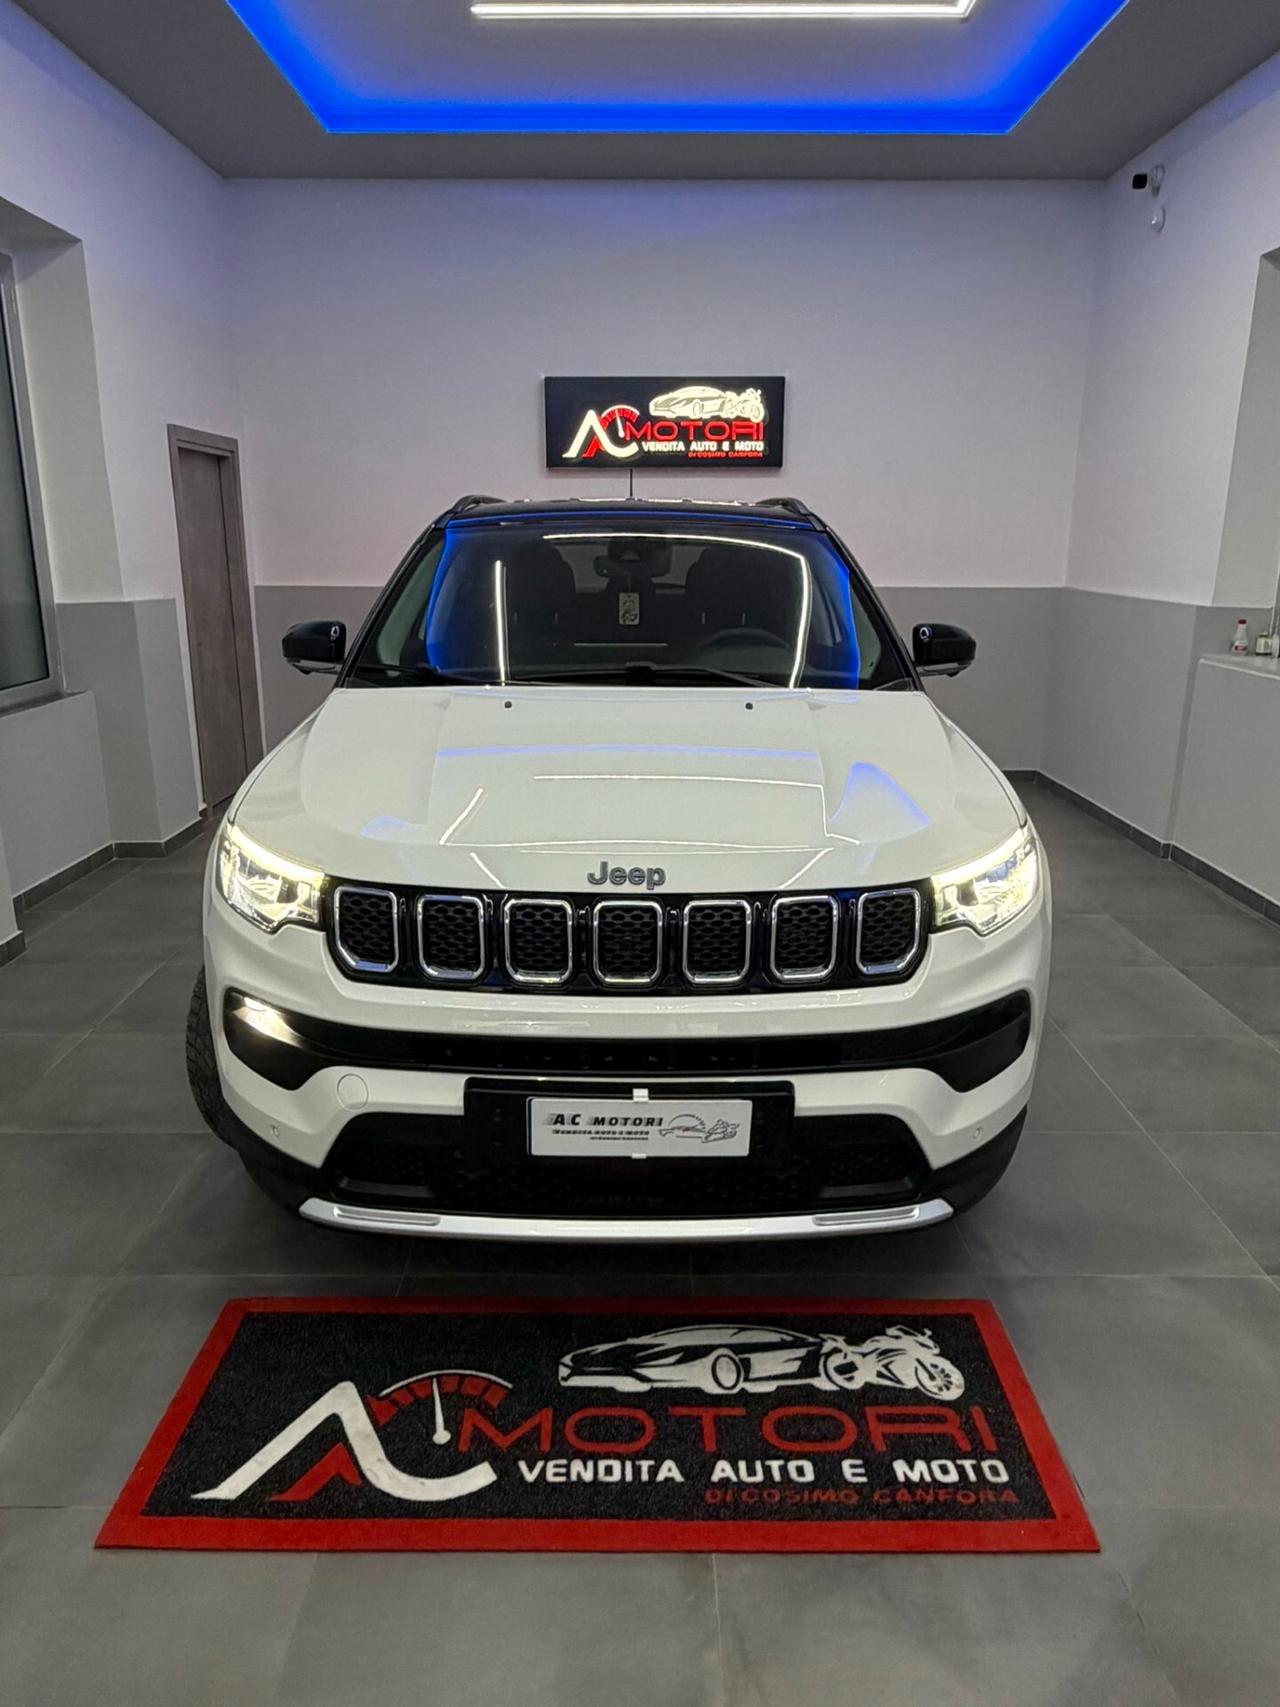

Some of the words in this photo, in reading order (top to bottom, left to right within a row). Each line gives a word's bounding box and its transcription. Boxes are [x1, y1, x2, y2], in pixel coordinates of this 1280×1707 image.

[626, 420, 764, 440] MOTORI
[642, 440, 685, 451] VENDITA
[690, 440, 717, 451] AUTO
[722, 440, 730, 451] E
[734, 440, 764, 451] MOTO
[587, 861, 666, 890] Jeep
[552, 1113, 581, 1126] AC
[592, 1116, 664, 1127] MOTORI
[457, 1405, 998, 1454] MOTORI
[517, 1458, 685, 1484] VENDITA
[709, 1458, 816, 1484] AUTO
[841, 1458, 869, 1484] E
[892, 1458, 1010, 1484] MOTO
[705, 1488, 733, 1505] DI
[736, 1488, 859, 1505] COSIMO
[873, 1488, 1020, 1505] CANFORA
